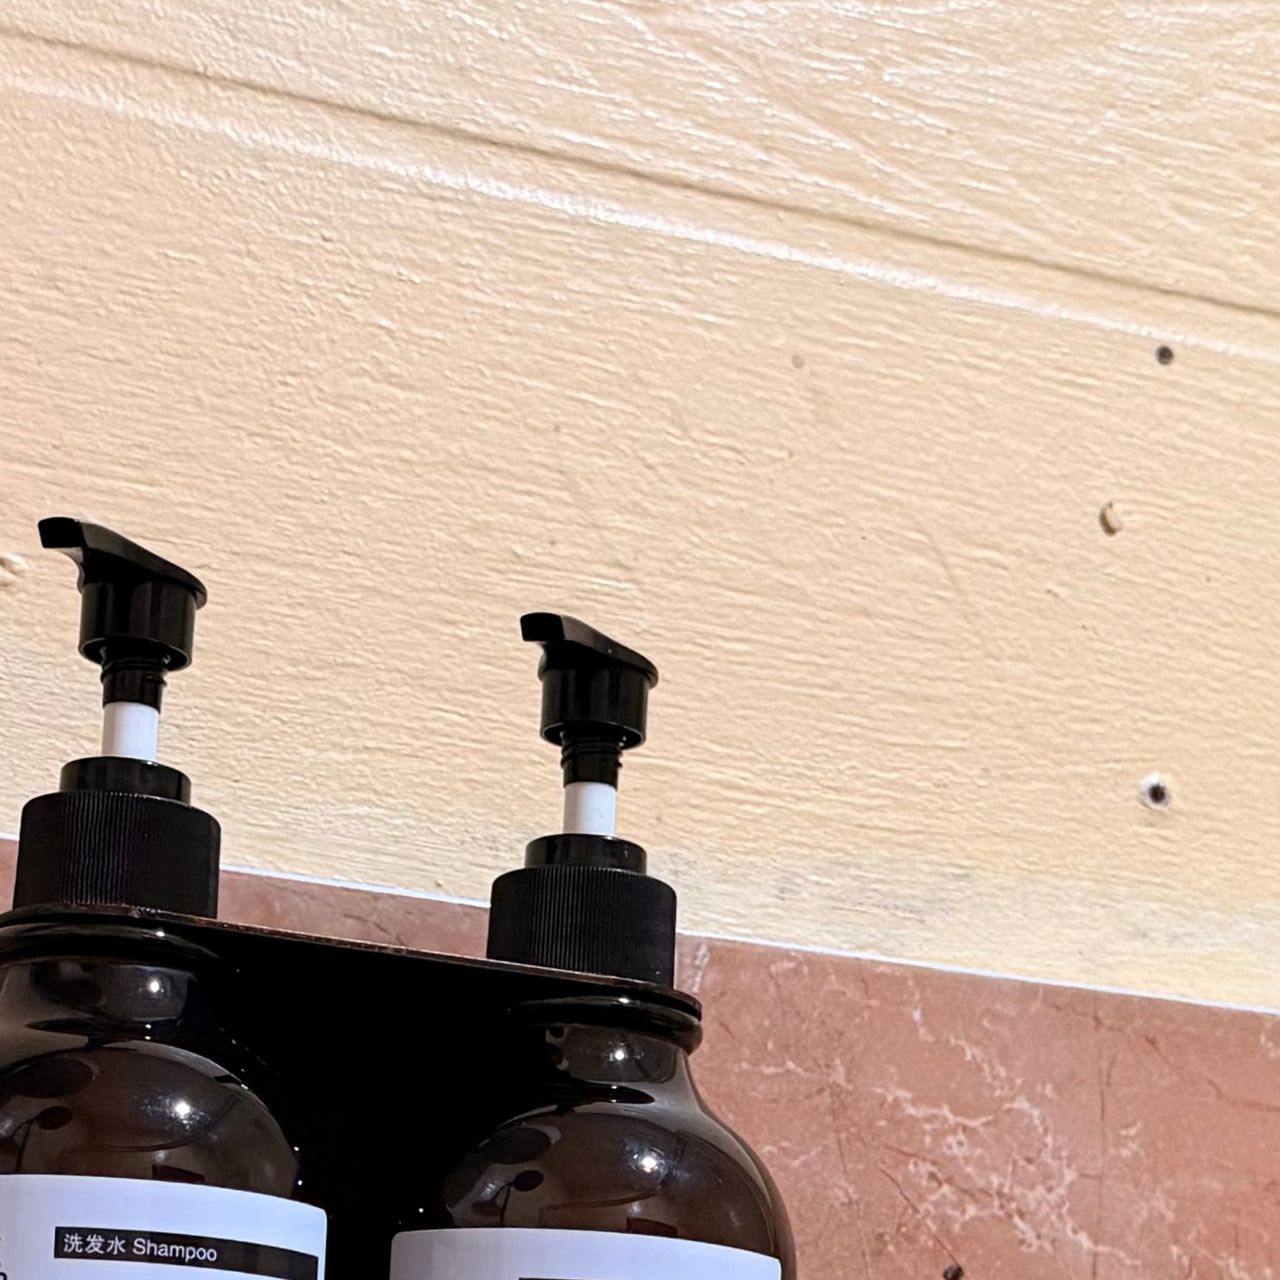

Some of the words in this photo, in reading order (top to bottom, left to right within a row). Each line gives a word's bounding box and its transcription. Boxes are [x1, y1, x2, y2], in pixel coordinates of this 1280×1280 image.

[64, 1233, 126, 1255] 洗发水
[133, 1238, 217, 1262] Shampoo
